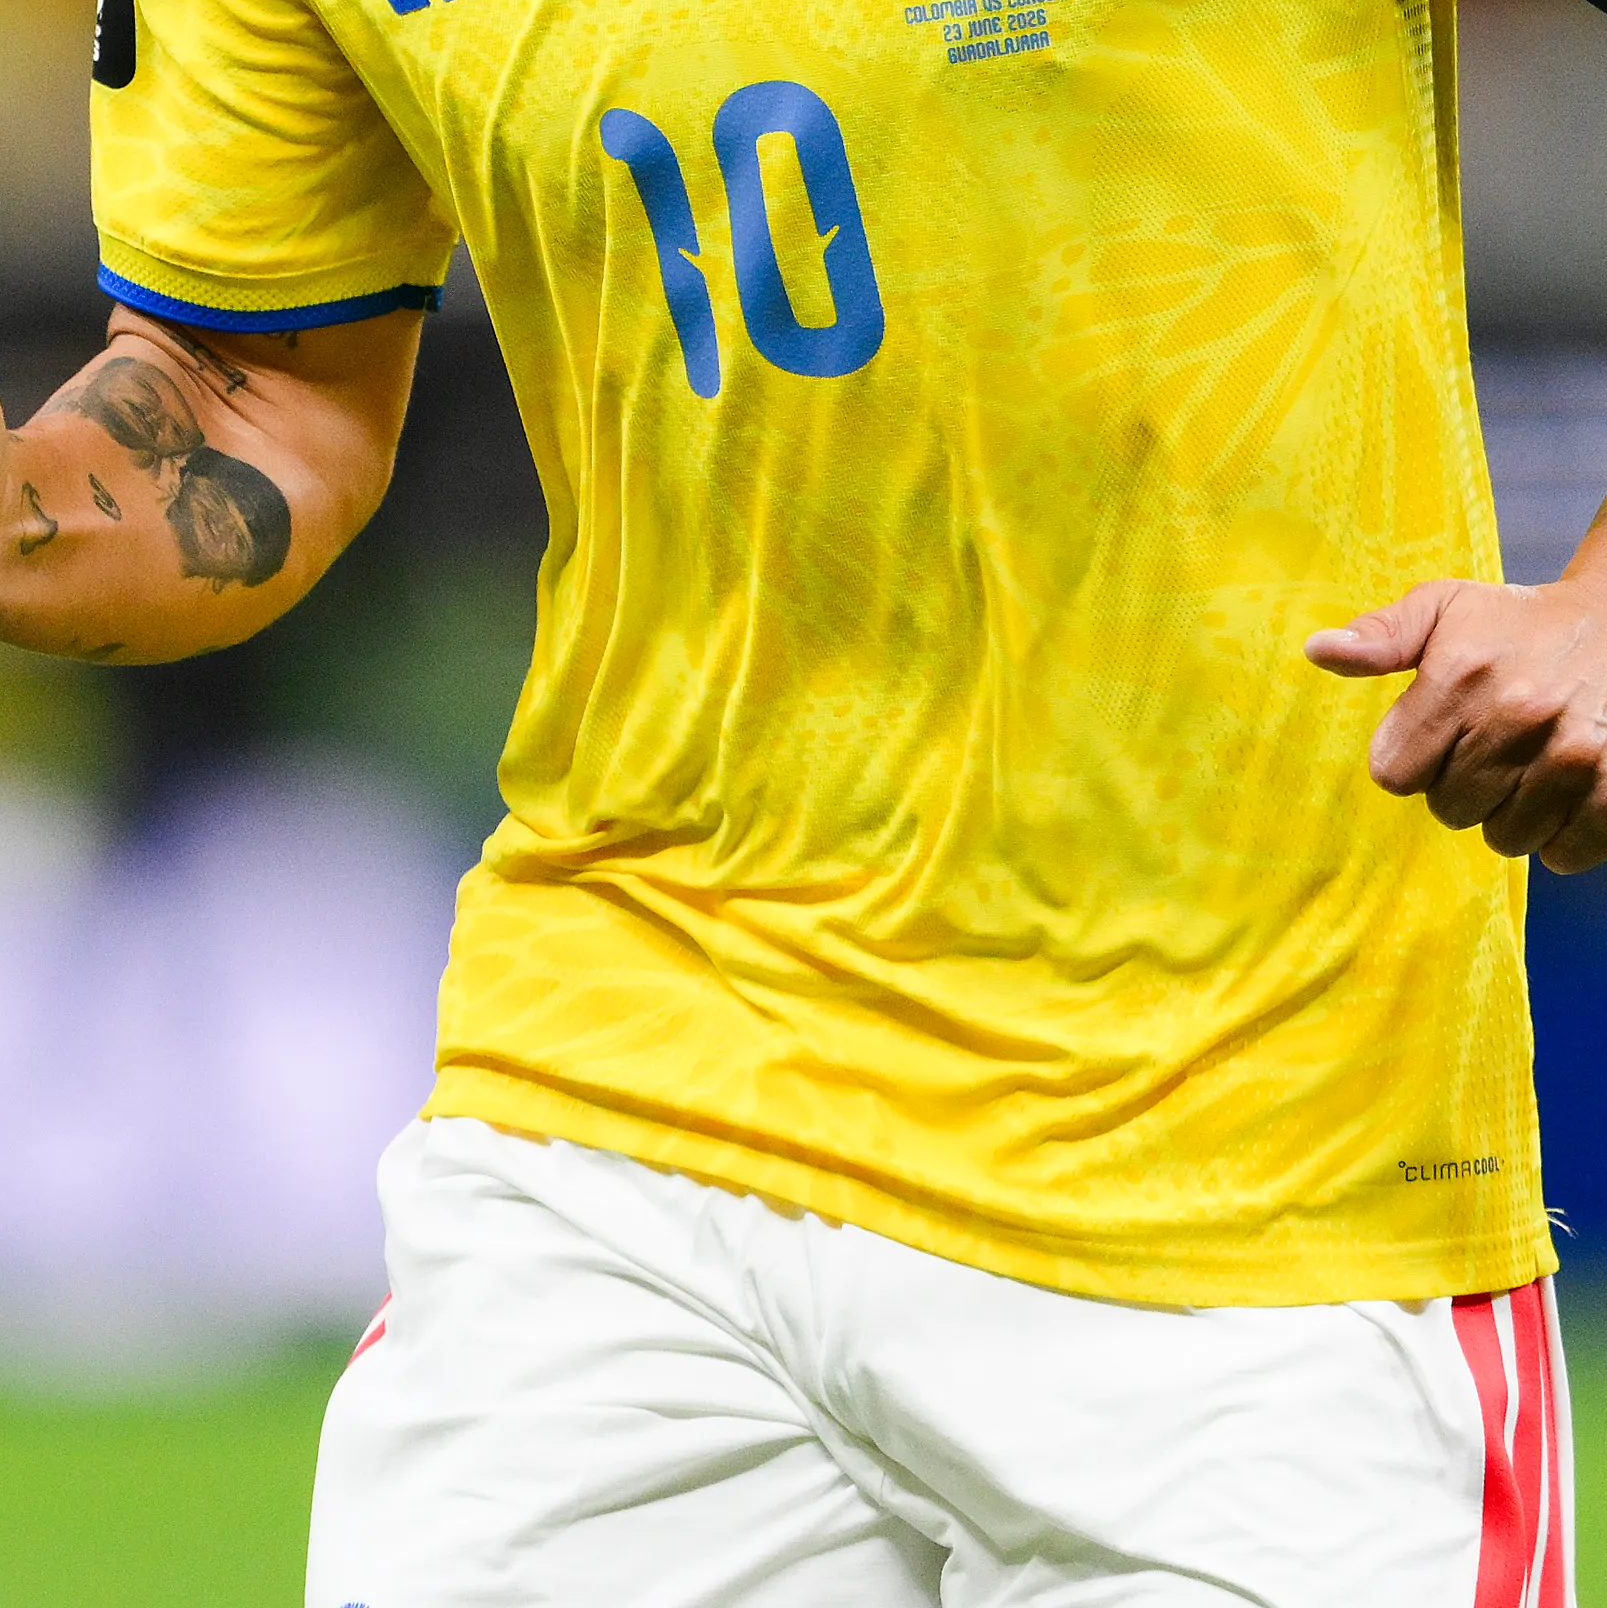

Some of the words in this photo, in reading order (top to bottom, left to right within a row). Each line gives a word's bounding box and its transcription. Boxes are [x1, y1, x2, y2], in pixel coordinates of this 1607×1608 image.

[943, 23, 962, 42] 23
[968, 16, 1003, 39] JUNE
[1008, 9, 1047, 32] 2026
[947, 31, 1051, 64] GUADALAJARA
[599, 80, 885, 399] 10
